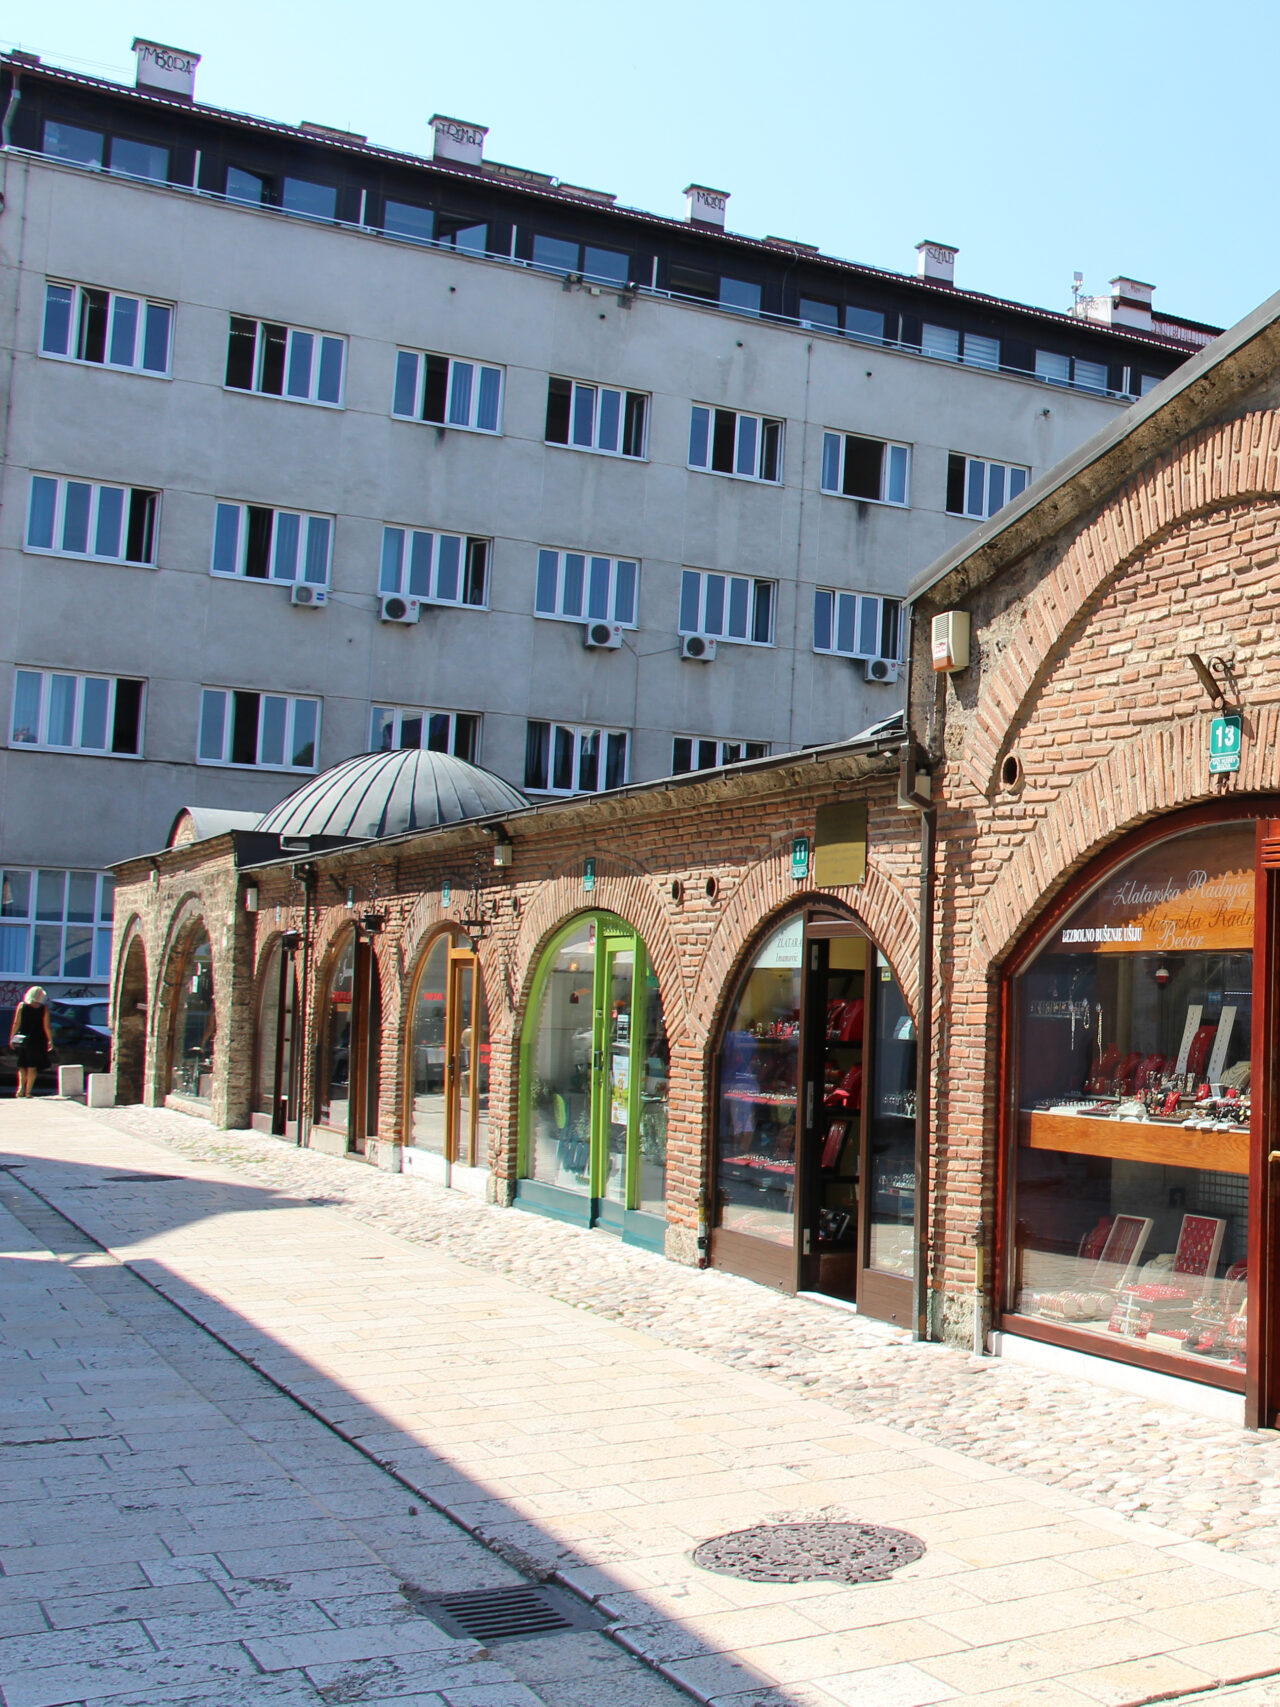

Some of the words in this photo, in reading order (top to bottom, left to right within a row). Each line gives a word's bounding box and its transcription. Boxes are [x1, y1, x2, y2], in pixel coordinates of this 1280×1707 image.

[1215, 725, 1235, 747] 13
[795, 844, 805, 861] 11
[1113, 877, 1181, 906] Zlatarska
[1187, 870, 1248, 909] Radnja
[1062, 927, 1095, 943] BEZBOLNO
[1095, 924, 1124, 942] BUŠENJE
[1123, 923, 1143, 942] UŠIJU
[1156, 919, 1205, 950] Bećar
